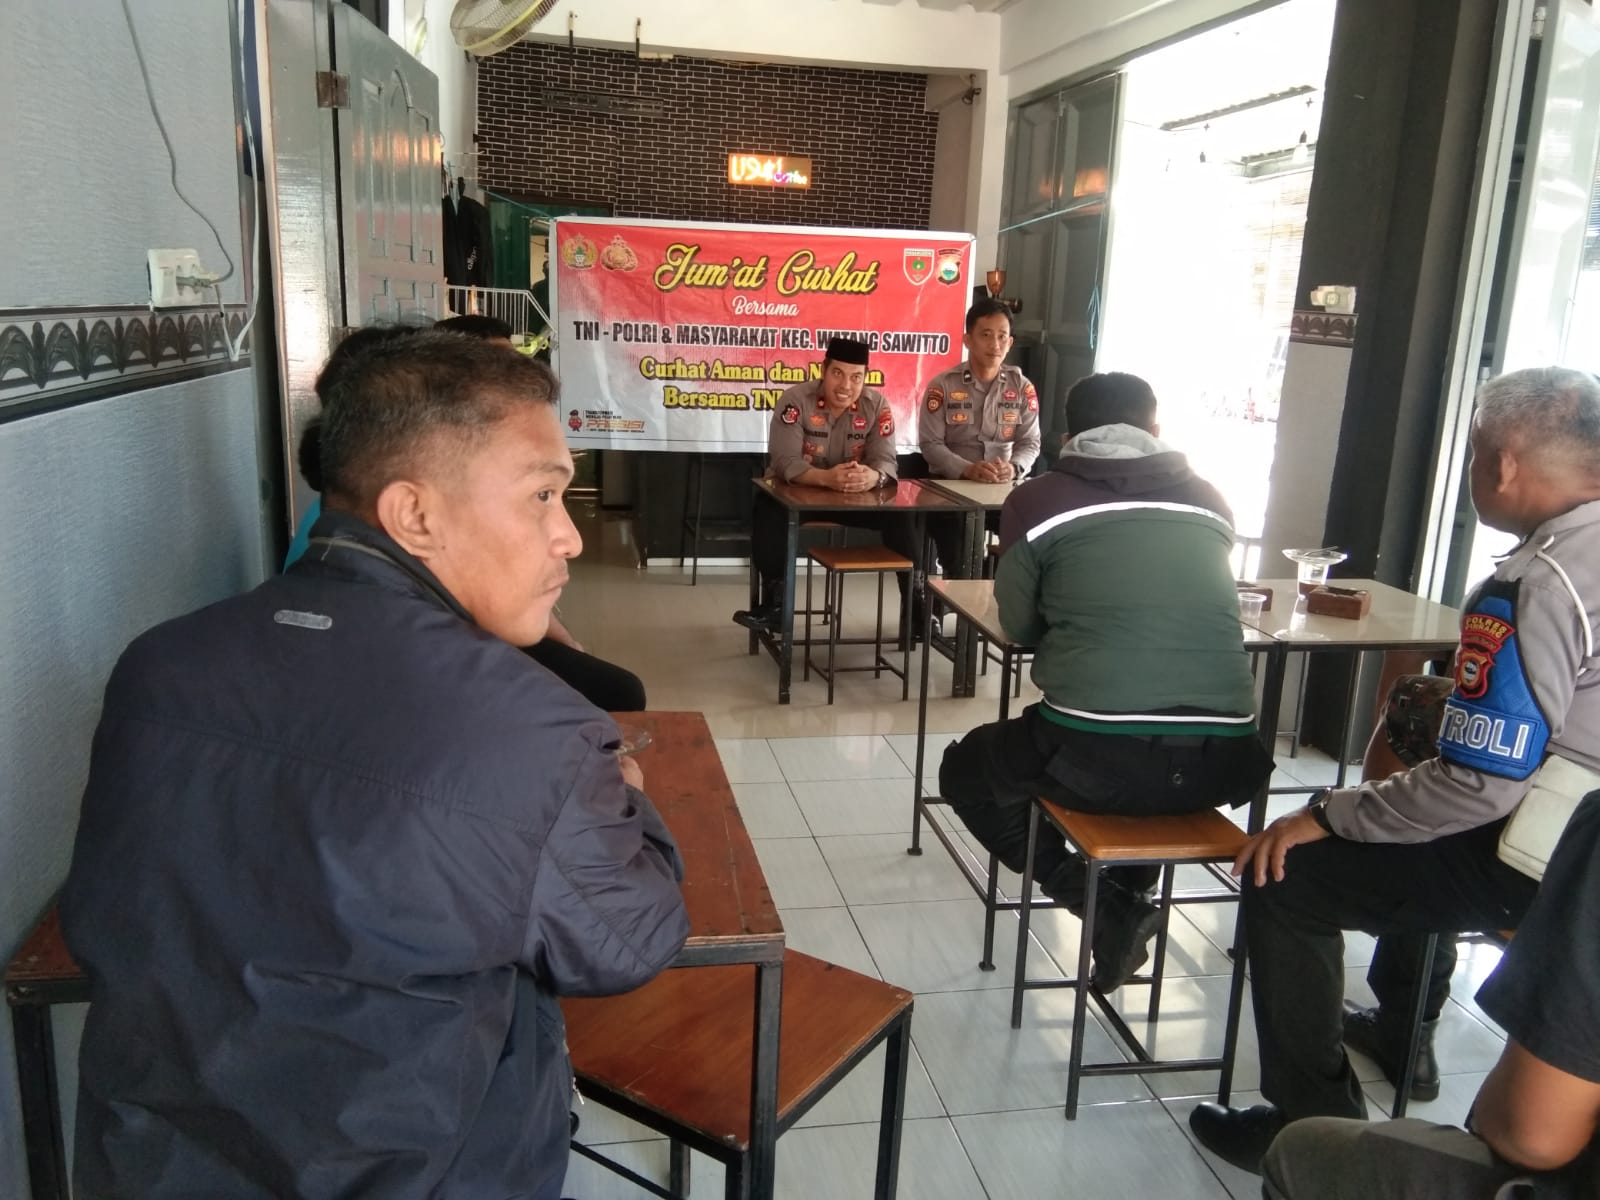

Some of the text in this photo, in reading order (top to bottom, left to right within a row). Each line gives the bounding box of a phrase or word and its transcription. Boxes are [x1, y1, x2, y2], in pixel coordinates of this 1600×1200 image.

[653, 243, 880, 295] Jum'at Curhat
[732, 296, 800, 316] Bersama
[573, 320, 600, 341] TNI
[612, 322, 658, 344] POLRI
[661, 327, 672, 344] &
[676, 325, 778, 349] MASYARAKAT
[781, 329, 813, 349] KEC.
[882, 333, 949, 354] SAWITTO
[639, 357, 708, 380] Curhat
[710, 359, 766, 382] Aman
[770, 361, 805, 383] dan
[663, 386, 784, 410] Bersama TN
